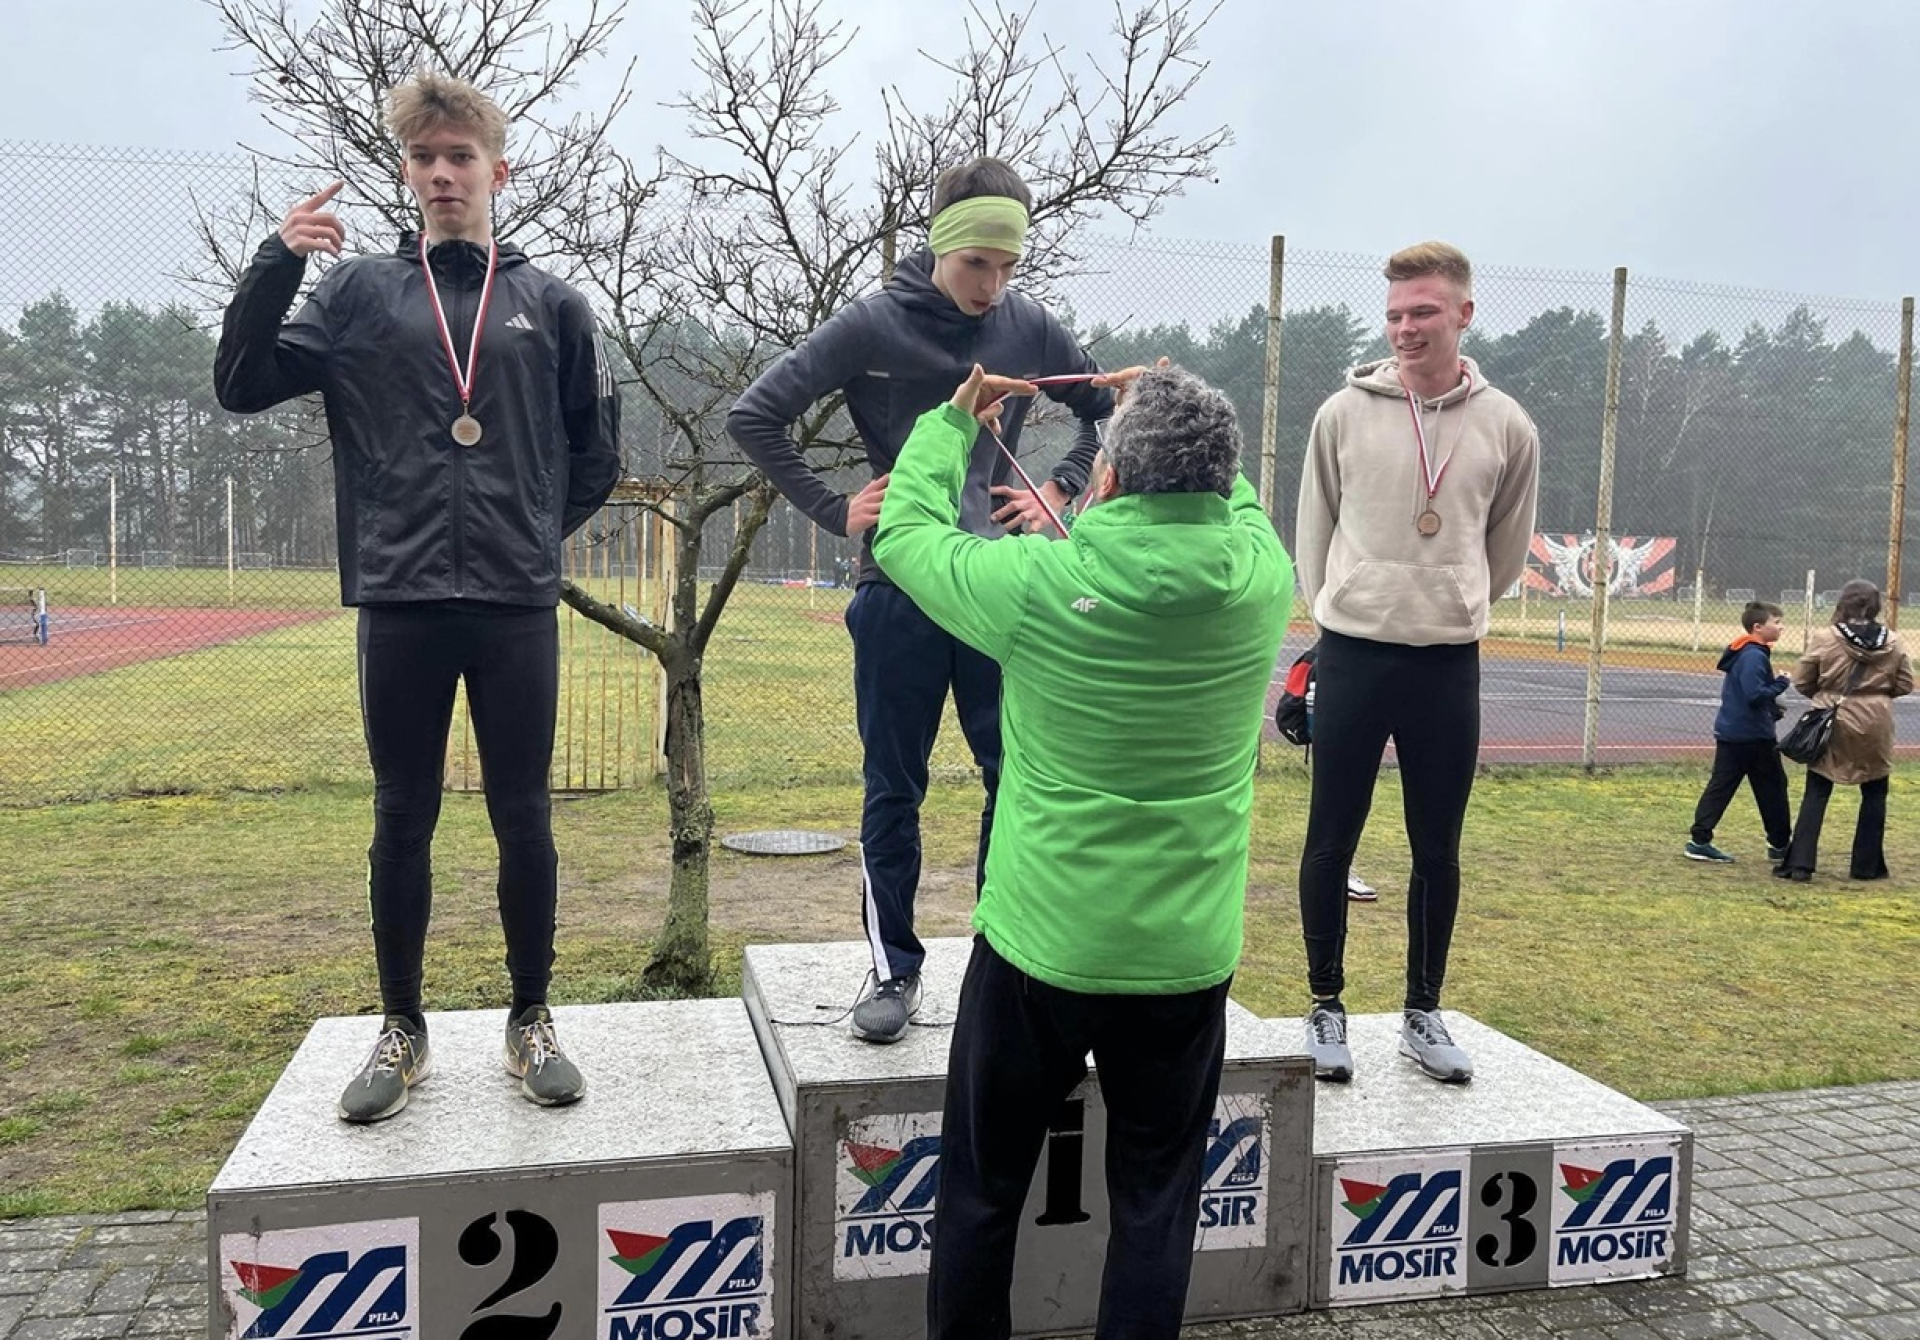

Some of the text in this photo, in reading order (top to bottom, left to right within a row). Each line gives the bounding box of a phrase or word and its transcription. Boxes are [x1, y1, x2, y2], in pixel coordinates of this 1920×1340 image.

[1071, 597, 1099, 612] 4F
[1200, 1196, 1257, 1228] SiR
[1475, 1171, 1537, 1266] 3
[1644, 1208, 1665, 1218] PILA
[1432, 1224, 1455, 1234] PILA
[1557, 1230, 1667, 1266] MOSiR
[457, 1209, 562, 1340] 2
[1338, 1246, 1457, 1285] MOSiR
[728, 1278, 757, 1289] PILA
[367, 1311, 399, 1323] PILA
[609, 1303, 761, 1340] MOSiR
